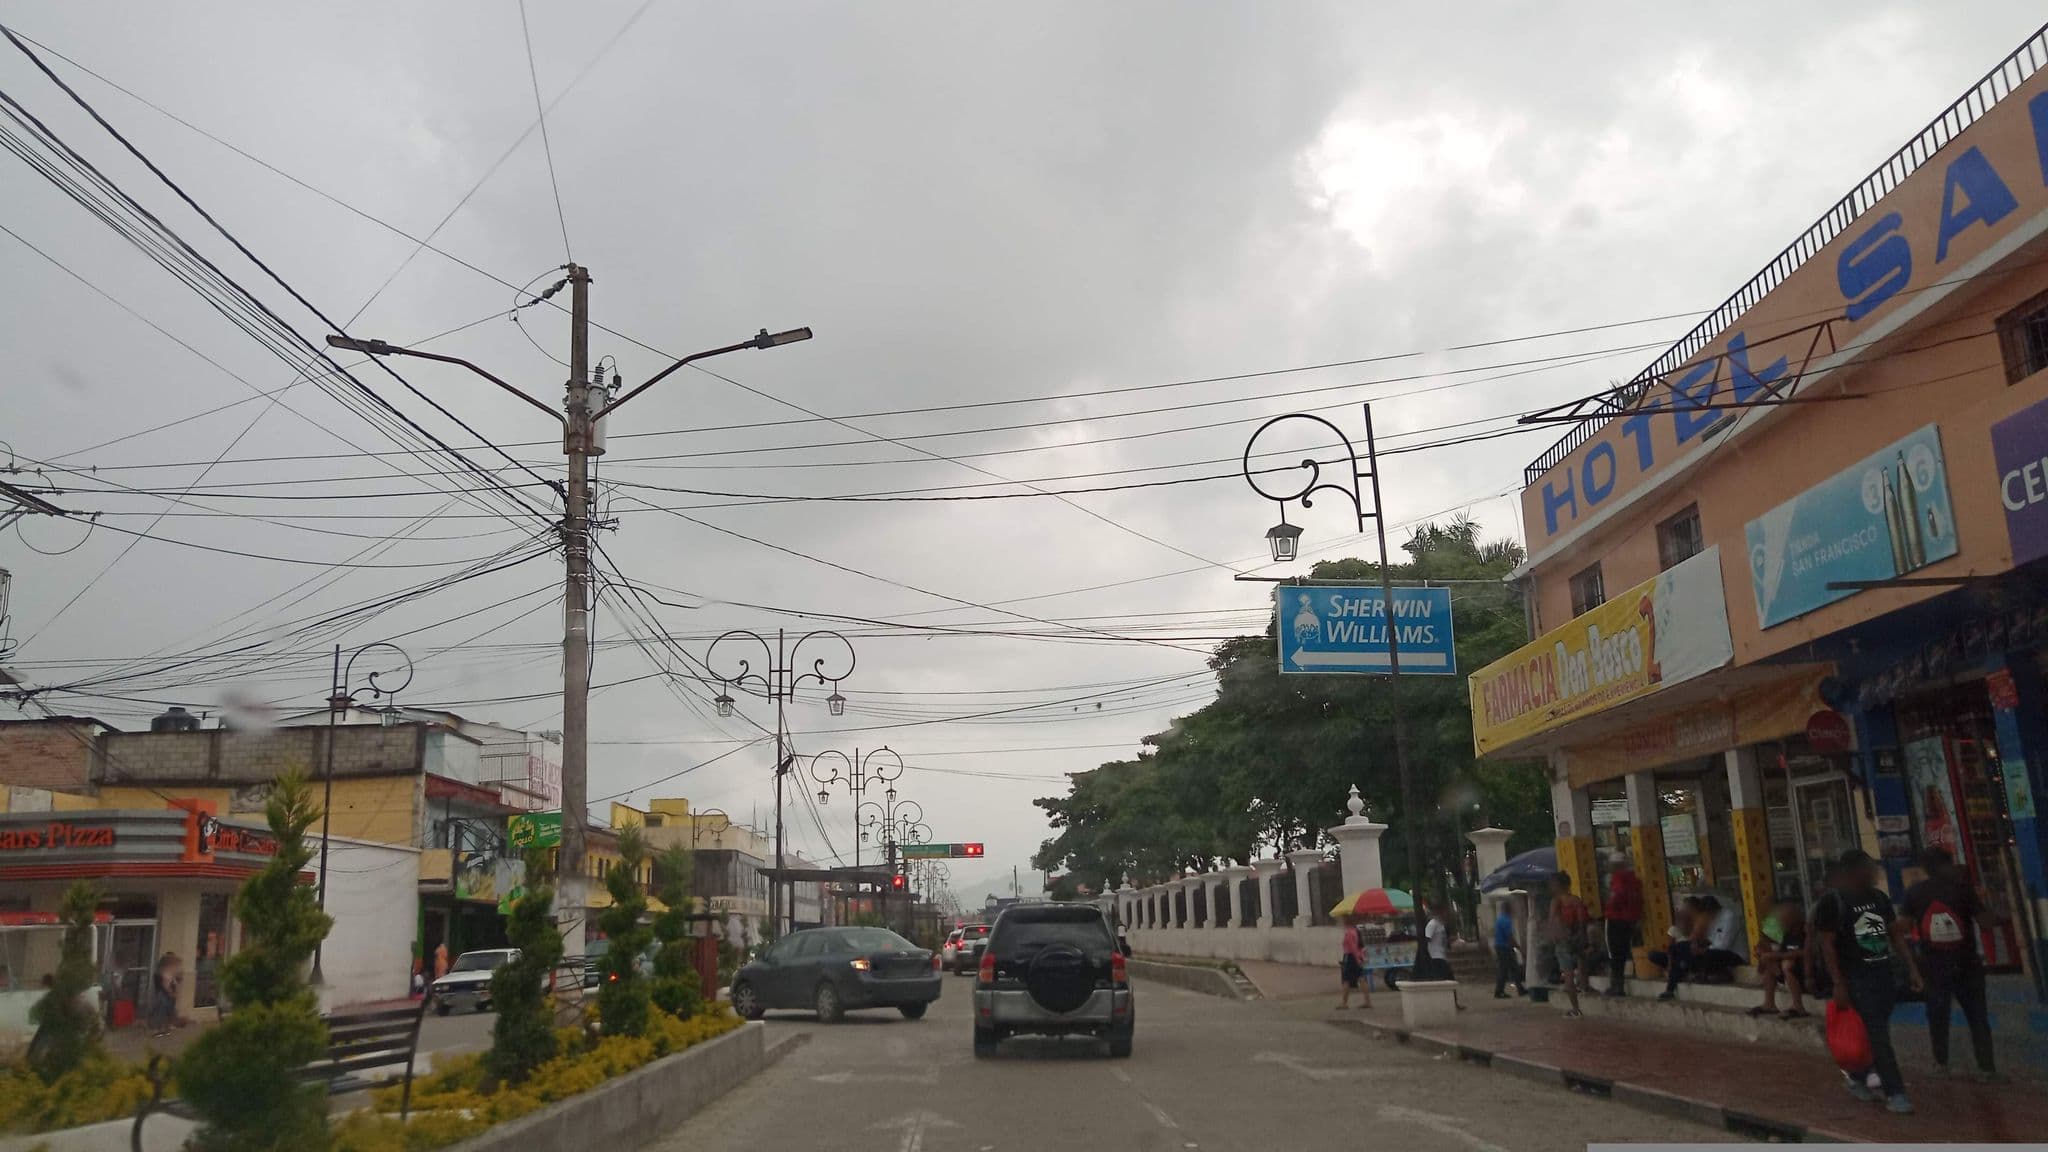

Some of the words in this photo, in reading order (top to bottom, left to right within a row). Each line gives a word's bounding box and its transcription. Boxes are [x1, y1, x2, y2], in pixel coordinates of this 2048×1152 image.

[1542, 331, 1789, 536] HOTEL
[1916, 458, 1929, 487] 6
[1791, 554, 1813, 578] SAN
[1814, 526, 1879, 570] FRANCISCO
[1328, 594, 1432, 618] SHERWIN
[1326, 620, 1435, 644] WILLIAMS
[1483, 652, 1558, 728] FARMACIA
[1554, 640, 1589, 699] Don
[1587, 623, 1642, 686] Bosco
[1638, 595, 1663, 685] 2
[0, 829, 40, 849] ars
[47, 822, 113, 849] Pizza
